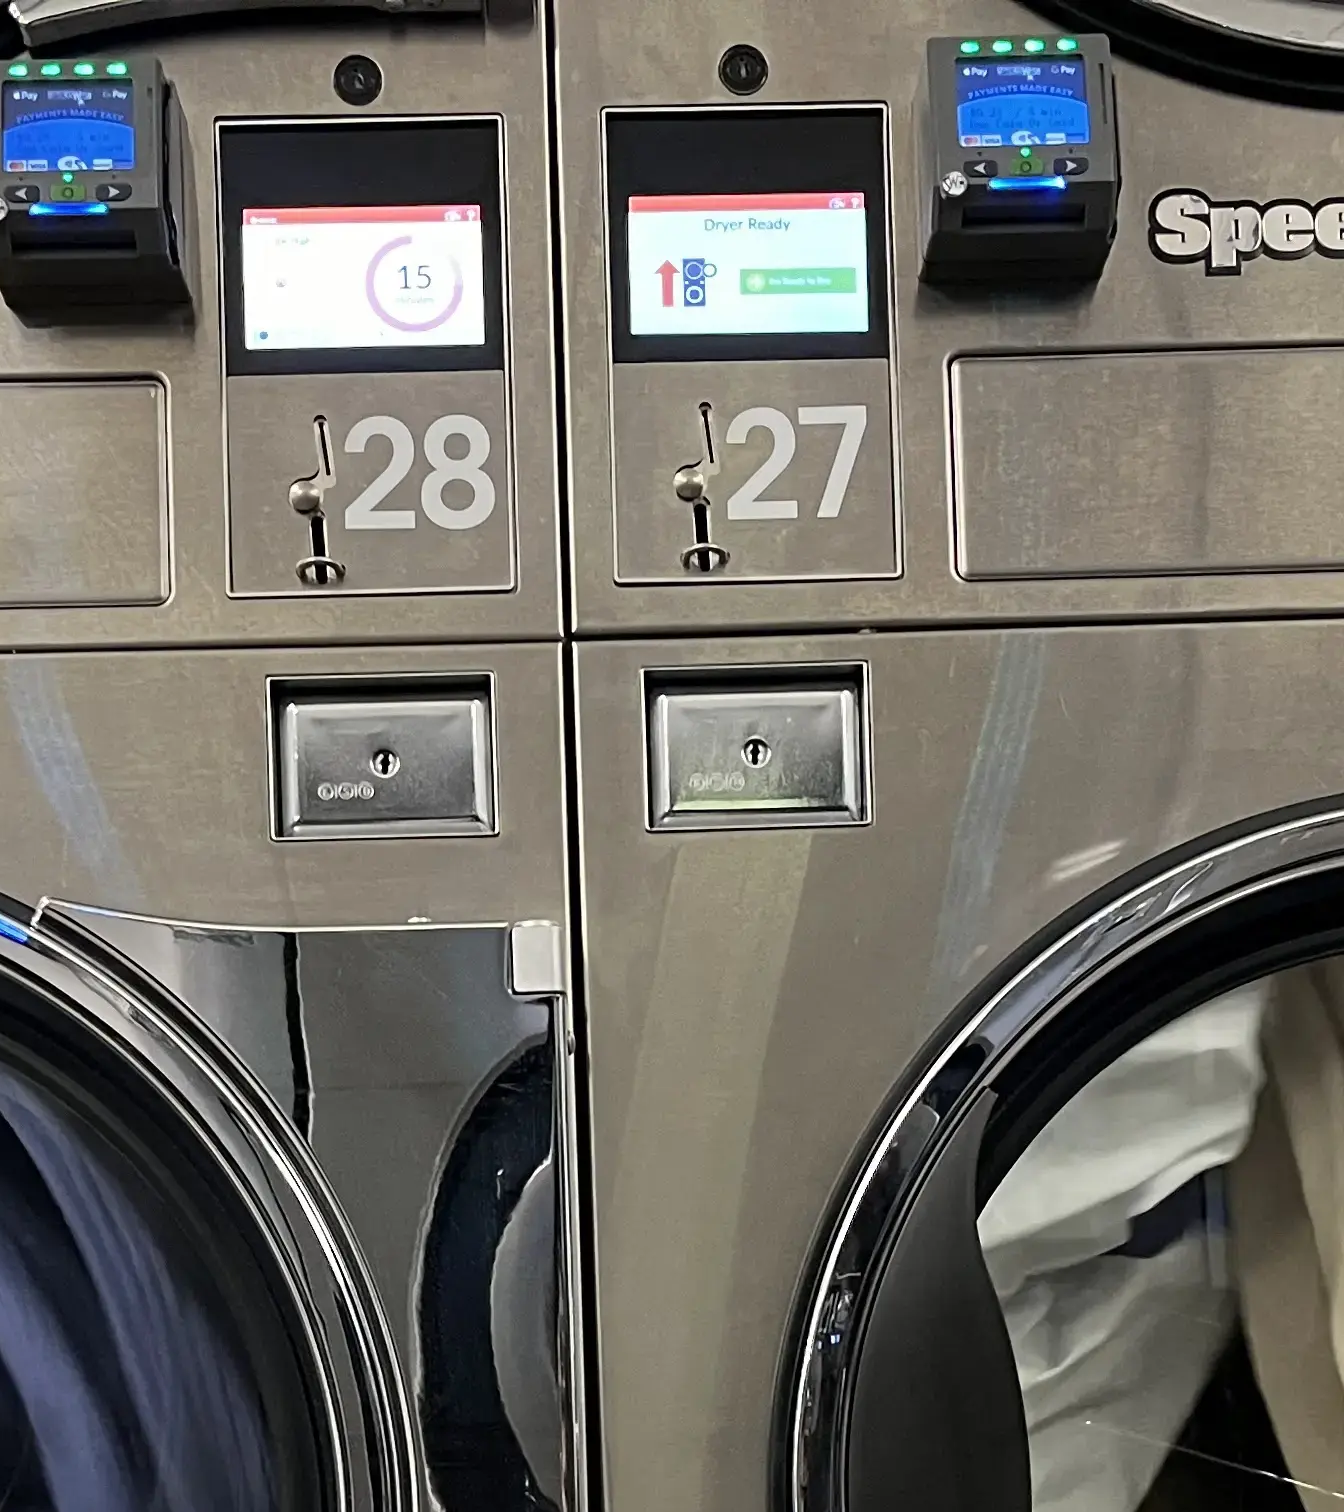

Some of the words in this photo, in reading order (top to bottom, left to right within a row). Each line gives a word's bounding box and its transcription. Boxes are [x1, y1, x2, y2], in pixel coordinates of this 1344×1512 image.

[704, 218, 743, 232] Dryer
[748, 216, 791, 232] Ready
[397, 265, 432, 289] 15
[345, 414, 496, 530] 28
[726, 405, 867, 520] 27
